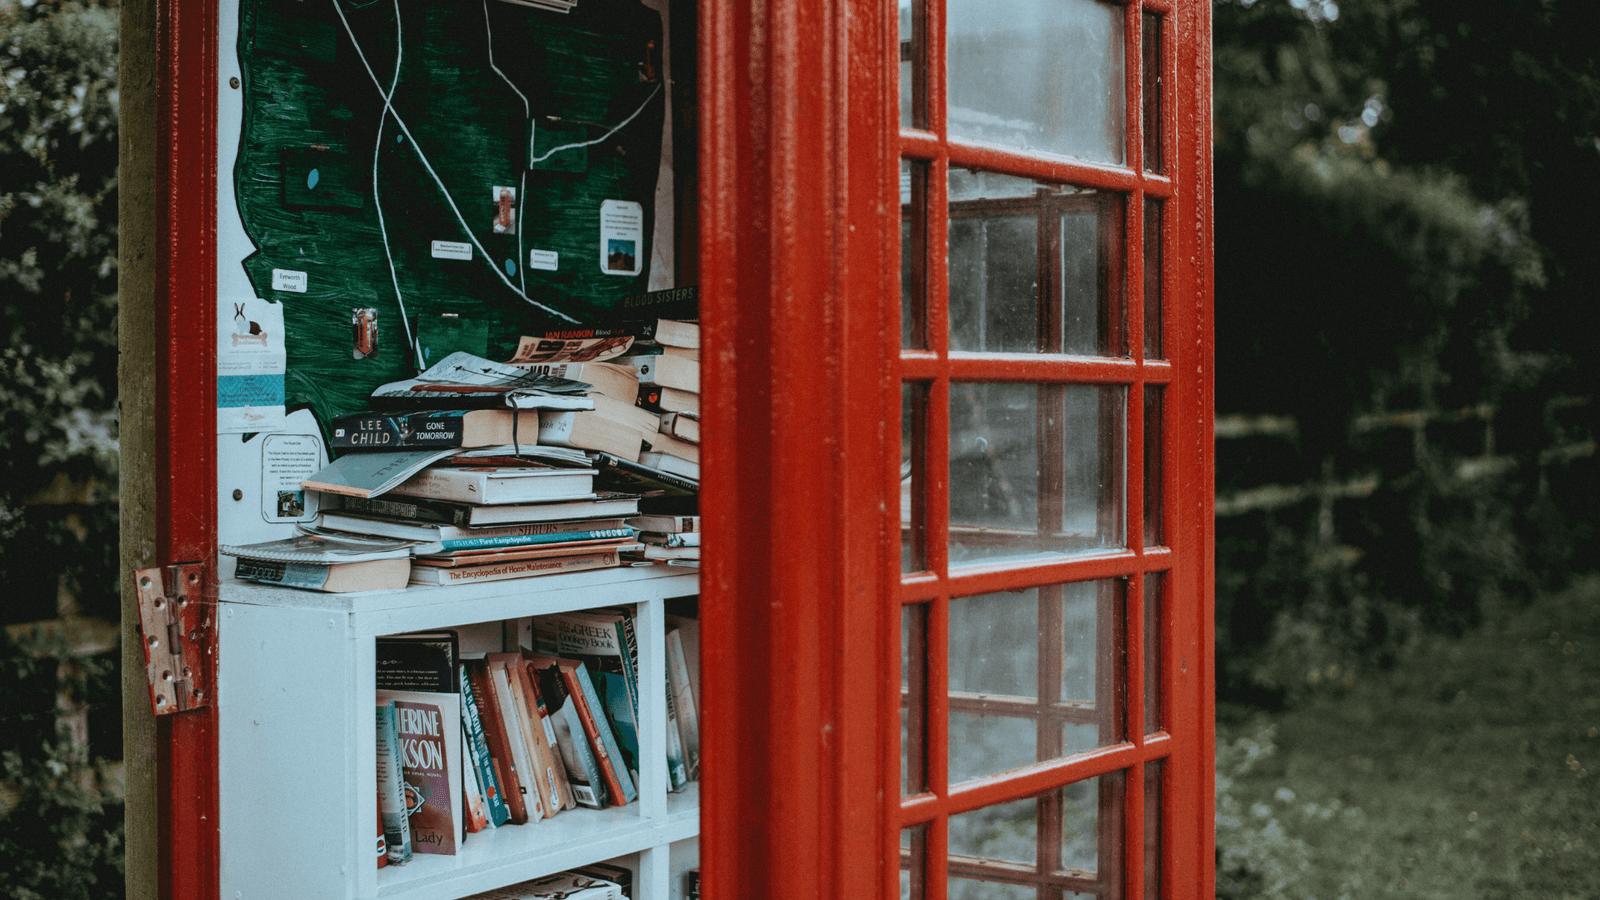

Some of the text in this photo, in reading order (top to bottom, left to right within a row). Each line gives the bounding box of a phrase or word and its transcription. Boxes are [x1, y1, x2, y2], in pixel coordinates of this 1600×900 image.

[280, 273, 300, 281] Eyeworth
[624, 288, 694, 308] BLOOD SISTERS
[545, 331, 560, 339] IAN
[560, 330, 594, 338] RANKIN
[360, 420, 382, 430] LEE
[426, 422, 445, 430] GONE
[351, 432, 390, 444] CHILD
[416, 431, 455, 440] TOMORROW
[390, 502, 417, 519] REPAIRS
[518, 524, 558, 536] SHRUBS
[479, 538, 494, 546] First
[450, 572, 462, 580] The
[462, 565, 502, 580] Encyclopedia
[501, 564, 508, 574] of
[509, 562, 526, 574] Home
[527, 560, 562, 572] Maintenance
[574, 624, 612, 640] GREEK
[624, 618, 638, 652] FRANK
[558, 632, 588, 648] Cookery
[590, 637, 614, 649] Book
[462, 674, 471, 693] IAN
[395, 708, 440, 736] ERINE
[466, 694, 482, 734] RANKIN
[398, 738, 444, 770] KSON
[415, 830, 443, 846] Lady
